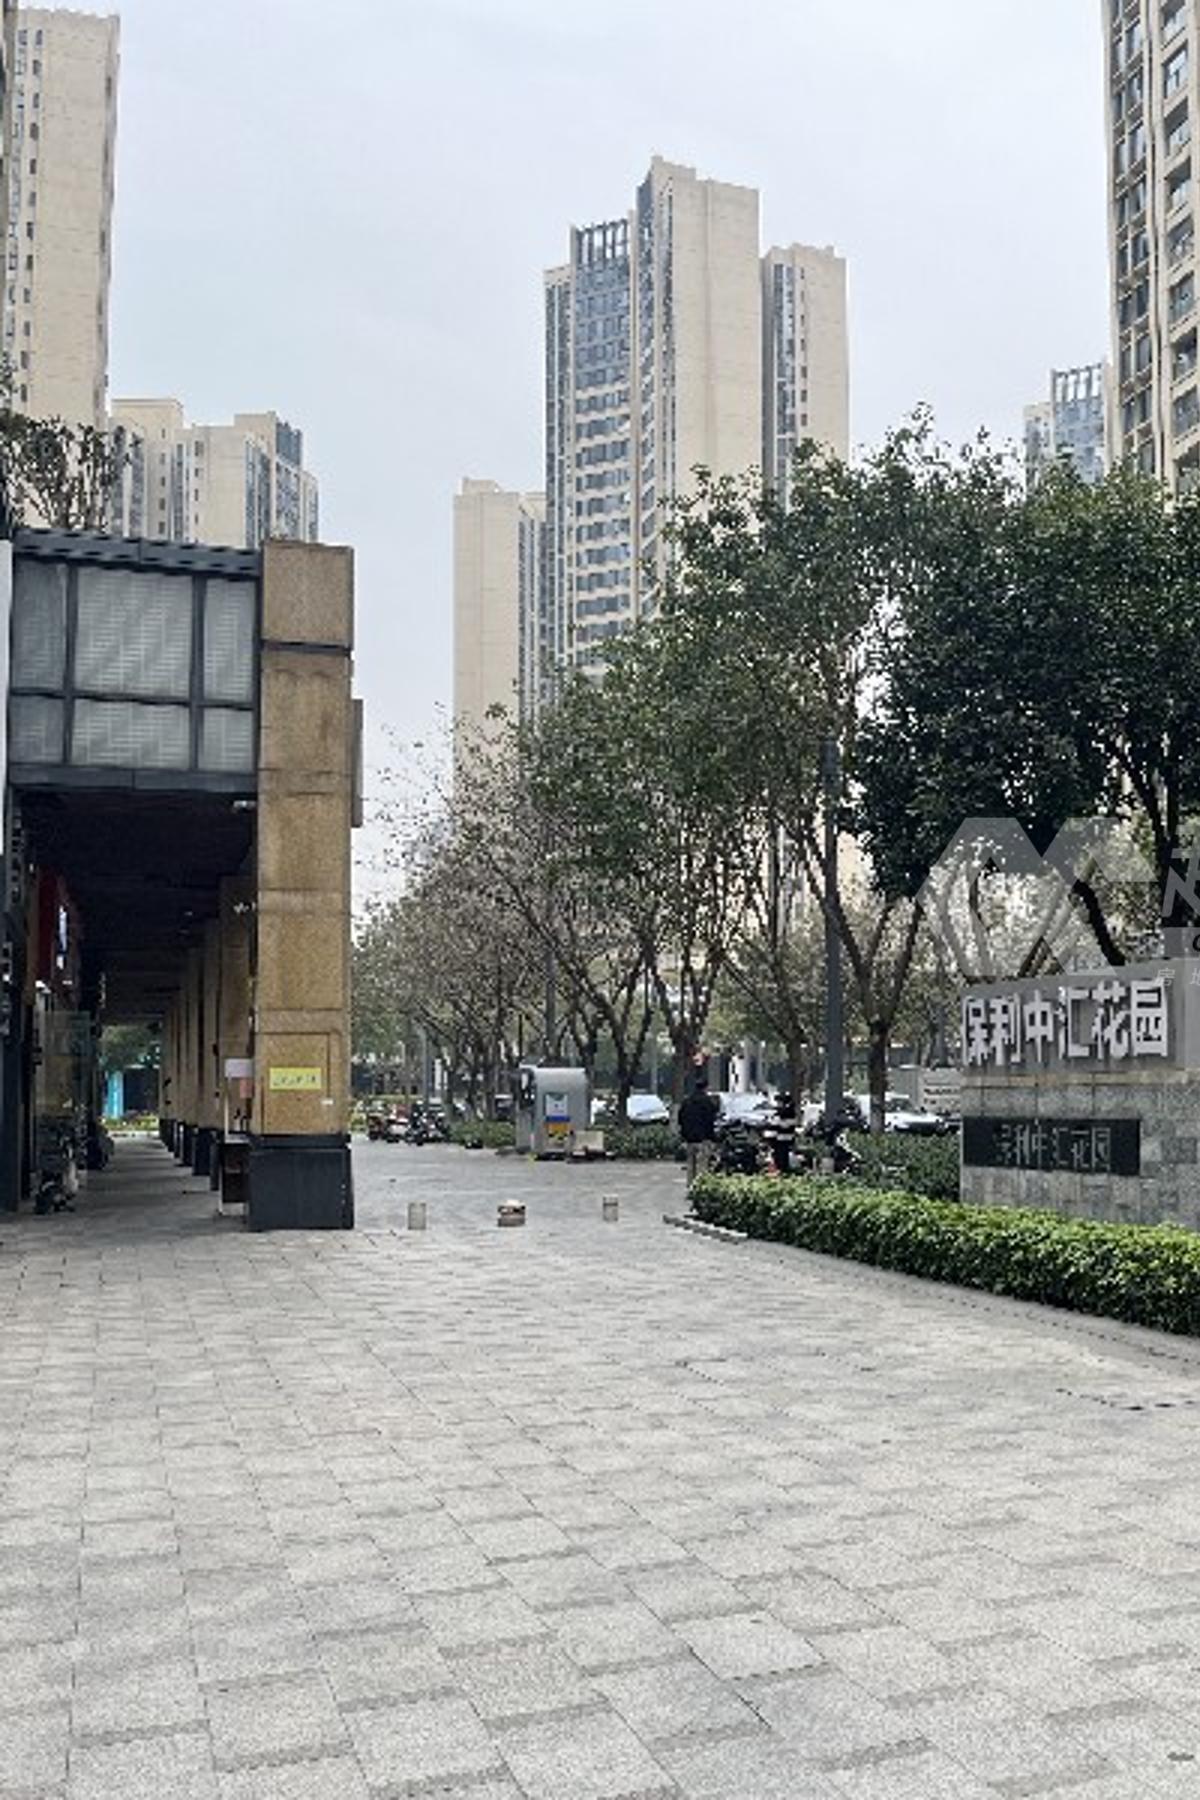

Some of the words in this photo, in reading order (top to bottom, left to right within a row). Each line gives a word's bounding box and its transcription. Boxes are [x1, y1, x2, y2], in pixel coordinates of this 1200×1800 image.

[962, 979, 1168, 1067] 保利中汇花园
